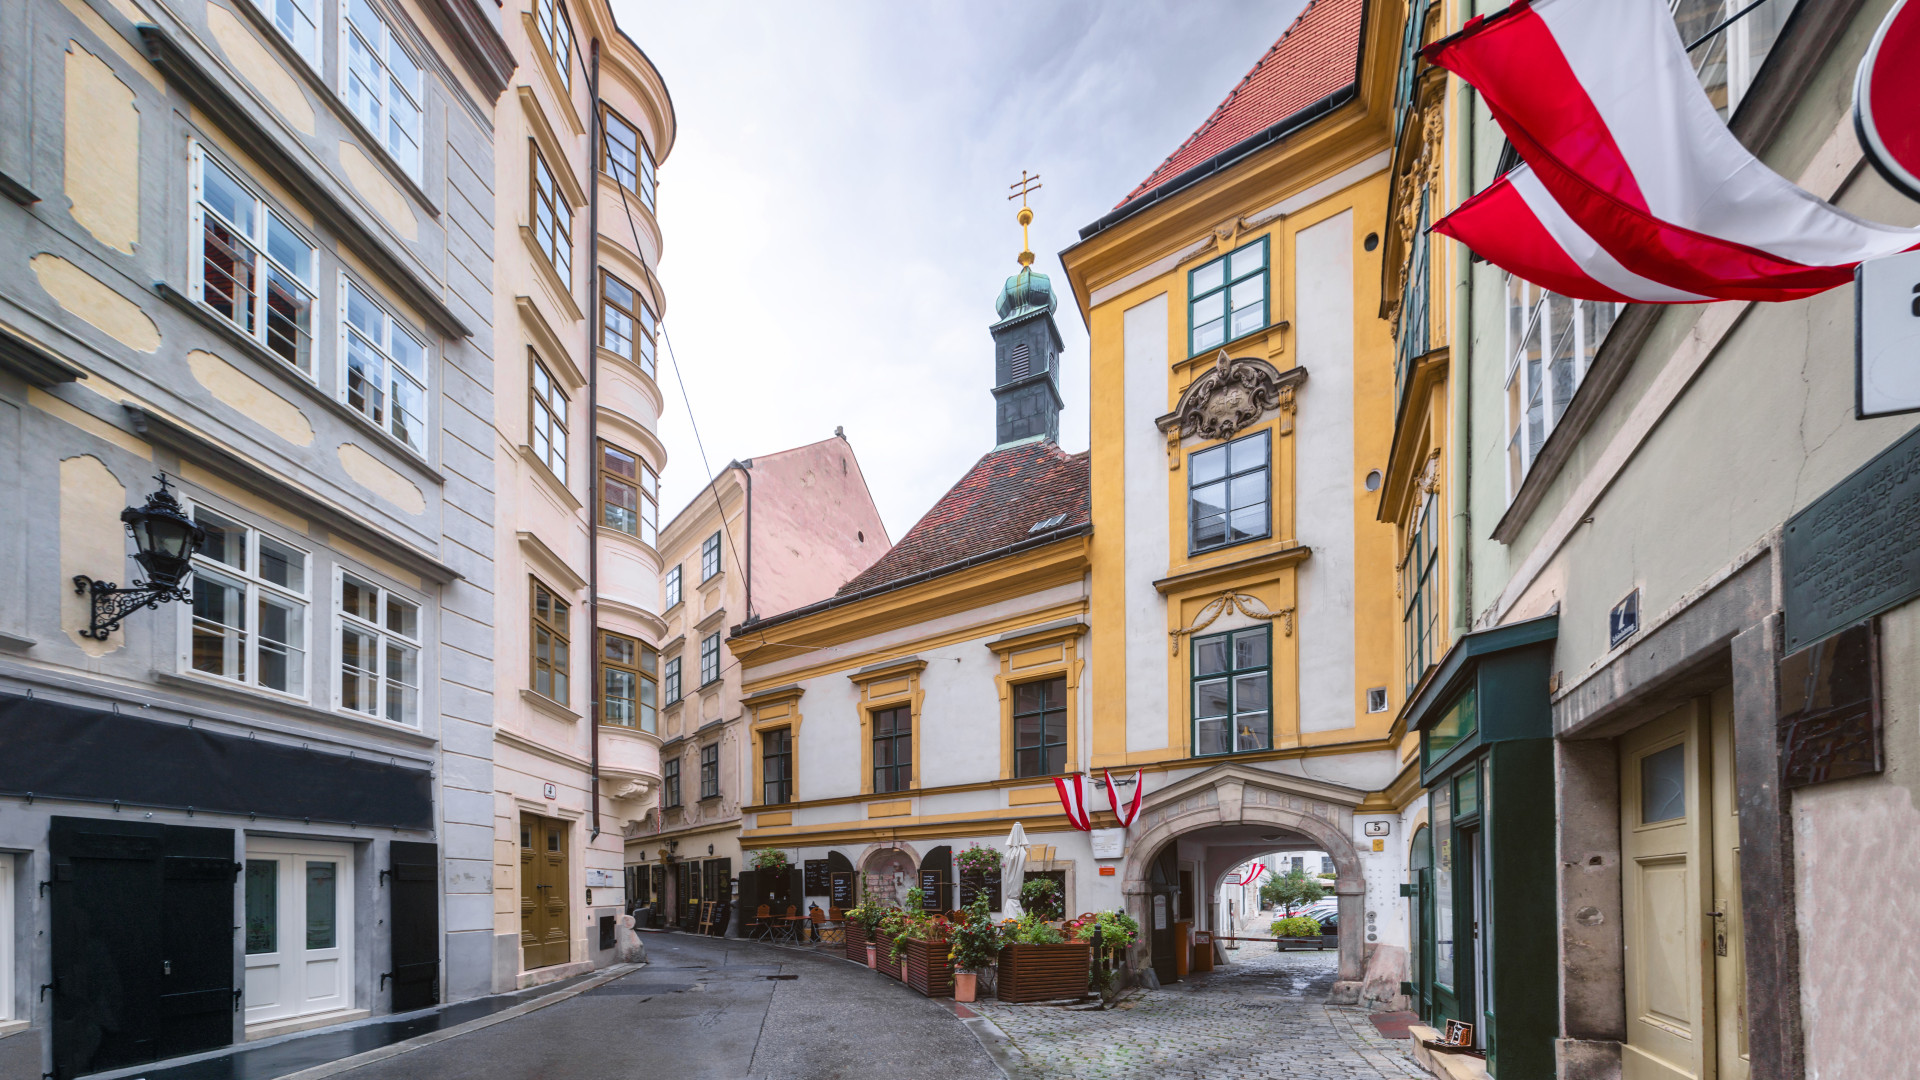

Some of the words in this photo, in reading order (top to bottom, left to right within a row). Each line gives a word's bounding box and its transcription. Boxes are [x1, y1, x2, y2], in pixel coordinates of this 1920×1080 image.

[1617, 600, 1628, 631] 7
[548, 786, 553, 795] 4
[1373, 822, 1381, 832] 5
